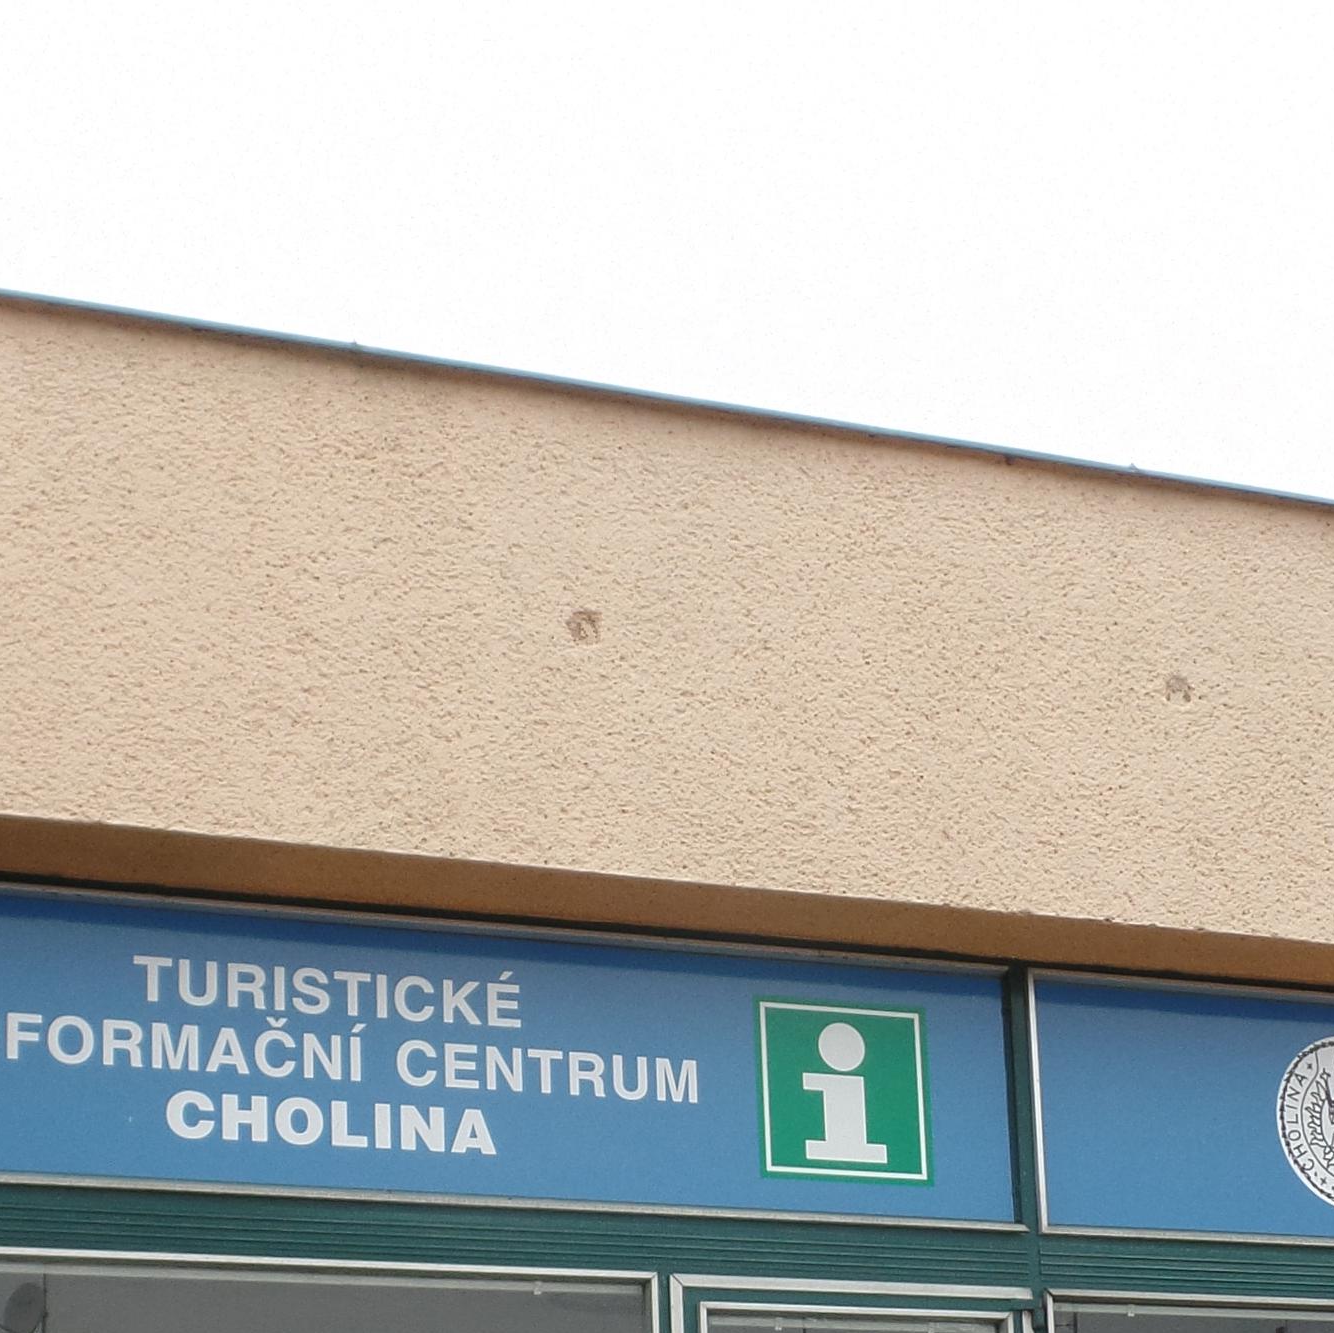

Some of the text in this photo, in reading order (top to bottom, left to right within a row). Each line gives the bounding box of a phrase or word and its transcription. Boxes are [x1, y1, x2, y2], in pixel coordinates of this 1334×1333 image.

[133, 954, 522, 1029] TURISTICKÉ
[396, 1039, 700, 1105] CENTRUM
[165, 1090, 497, 1156] CHOLINA
[1286, 1072, 1315, 1172] CHOLINA
